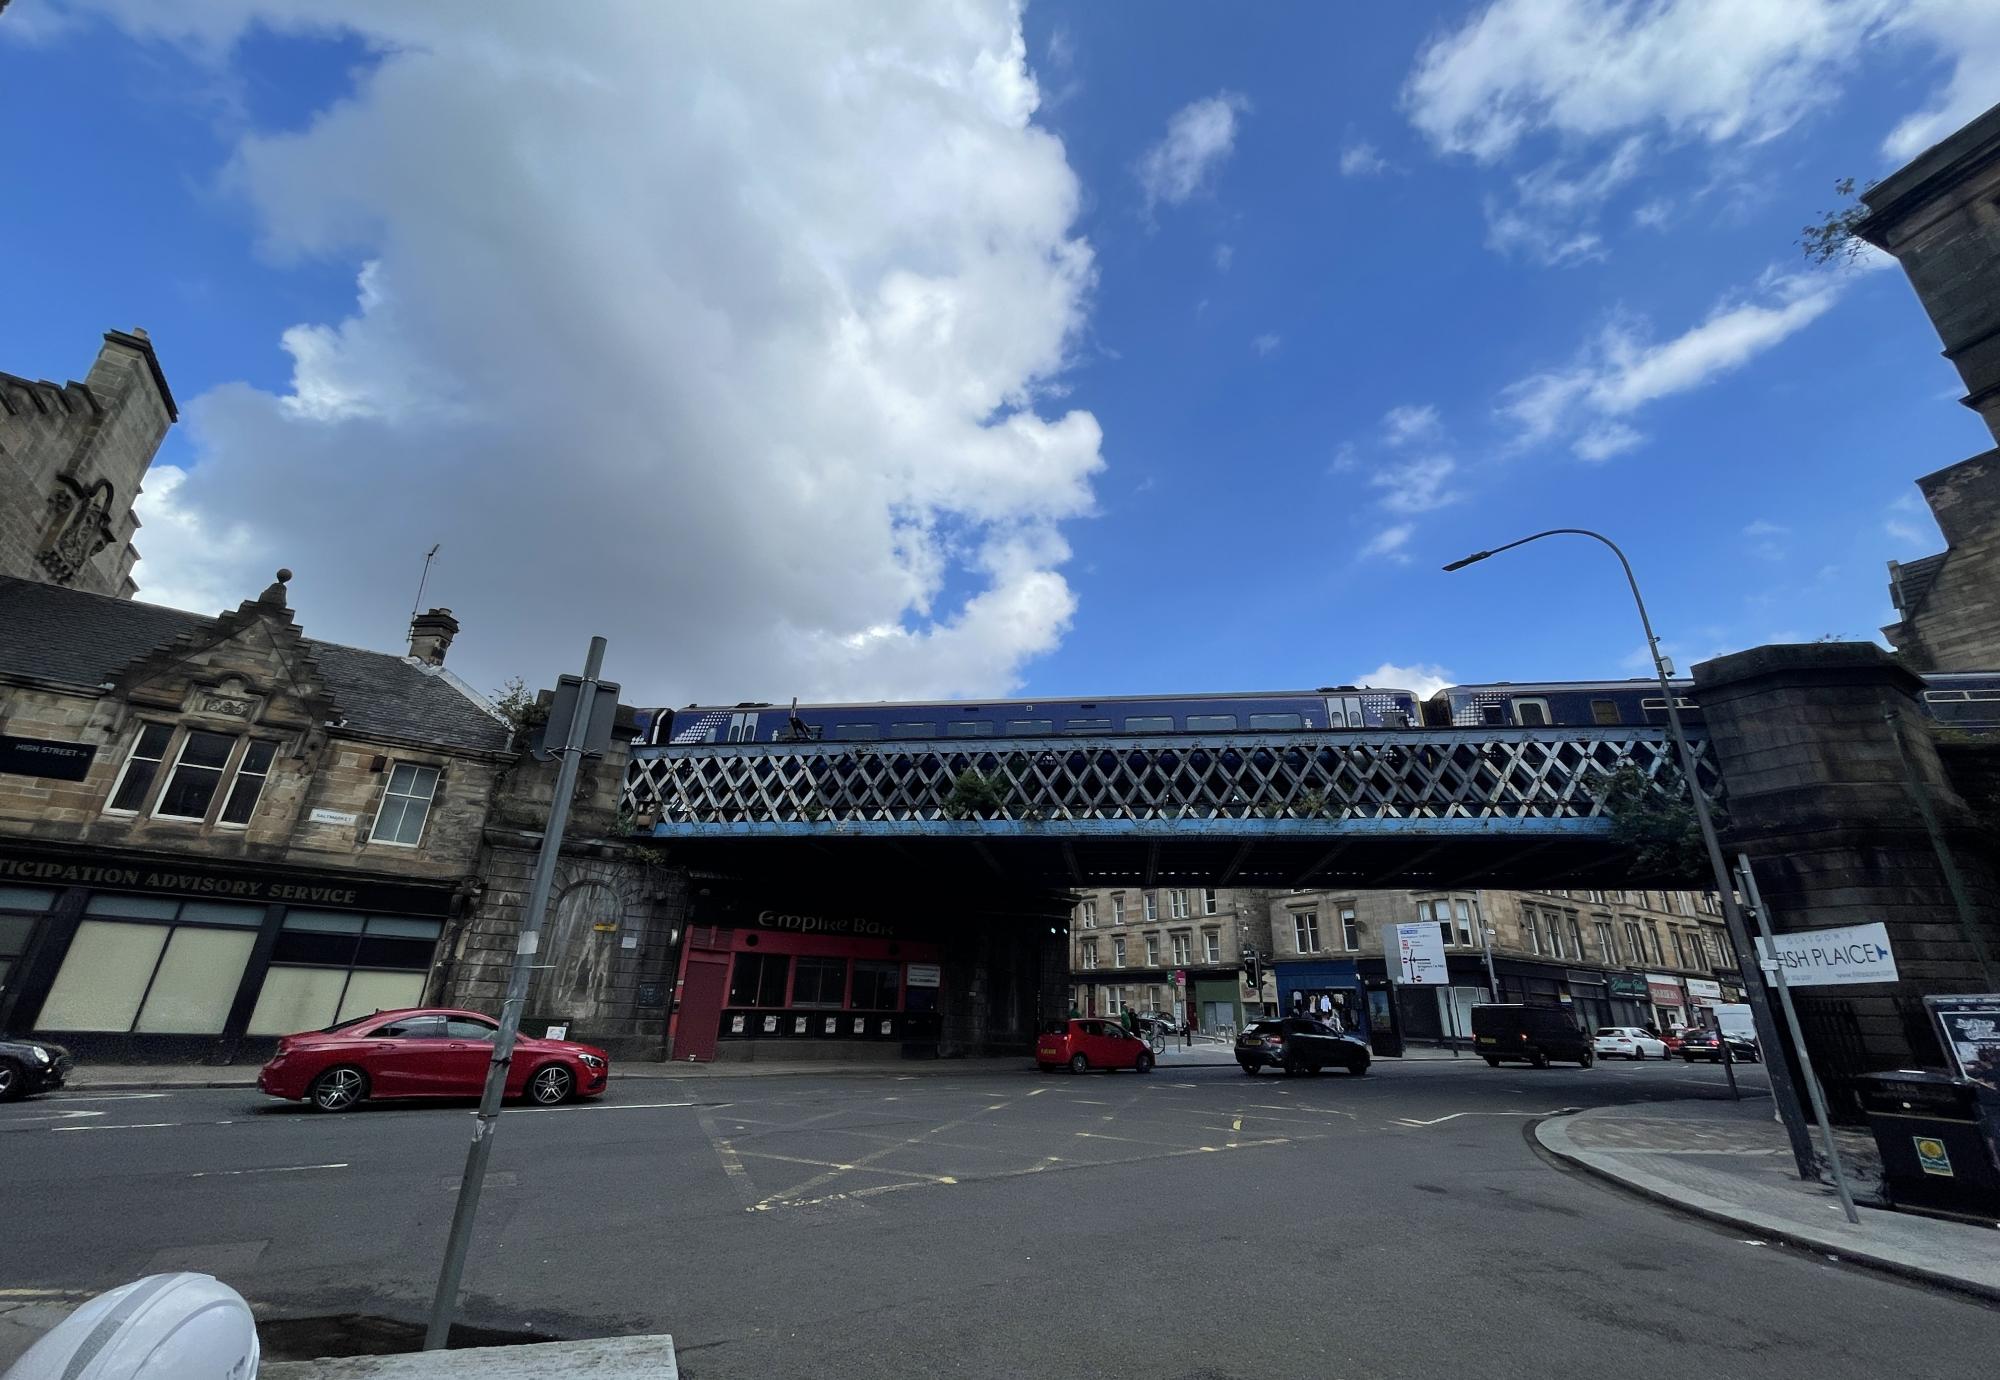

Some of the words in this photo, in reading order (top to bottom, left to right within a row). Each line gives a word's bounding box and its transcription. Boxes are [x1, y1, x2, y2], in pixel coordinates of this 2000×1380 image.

[41, 745, 79, 757] STREET
[144, 871, 262, 896] ADVISORY
[267, 883, 357, 905] SERVICE
[1811, 943, 1877, 967] PLAICE
